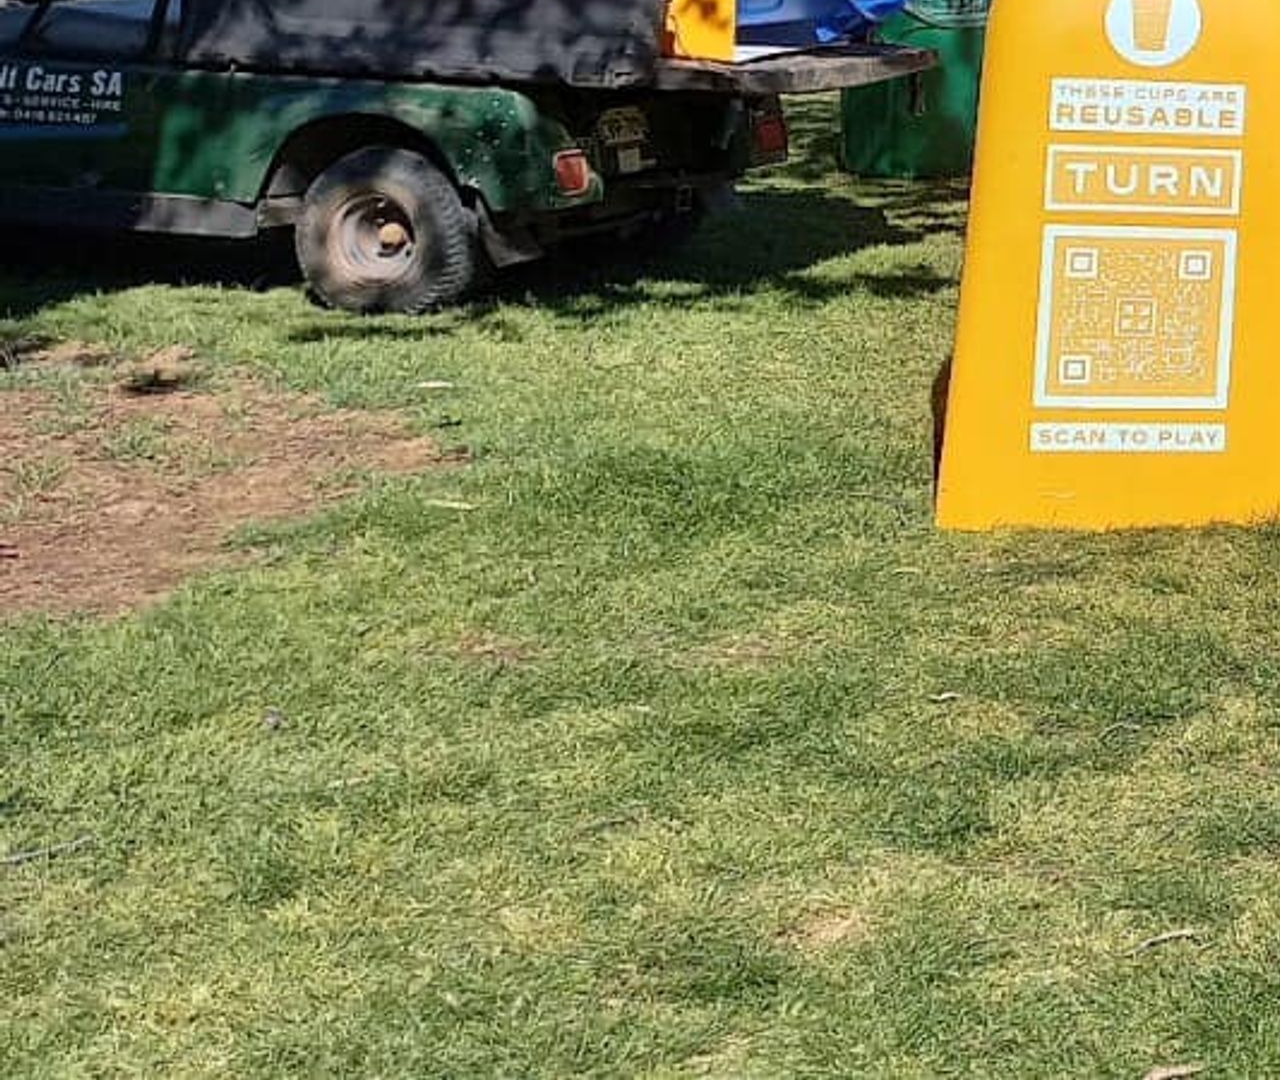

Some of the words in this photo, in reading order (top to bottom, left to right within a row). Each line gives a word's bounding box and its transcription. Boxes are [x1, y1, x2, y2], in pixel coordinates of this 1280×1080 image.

[26, 66, 82, 93] Cars
[90, 69, 122, 96] SA
[1058, 85, 1125, 99] THESE
[1135, 87, 1187, 102] CUPS
[1198, 89, 1237, 103] ARE
[1055, 103, 1237, 129] REUSABLE
[1065, 162, 1223, 198] TURN
[1038, 429, 1106, 445] SCAN
[1117, 429, 1148, 445] TO
[1158, 430, 1219, 445] PLAY
